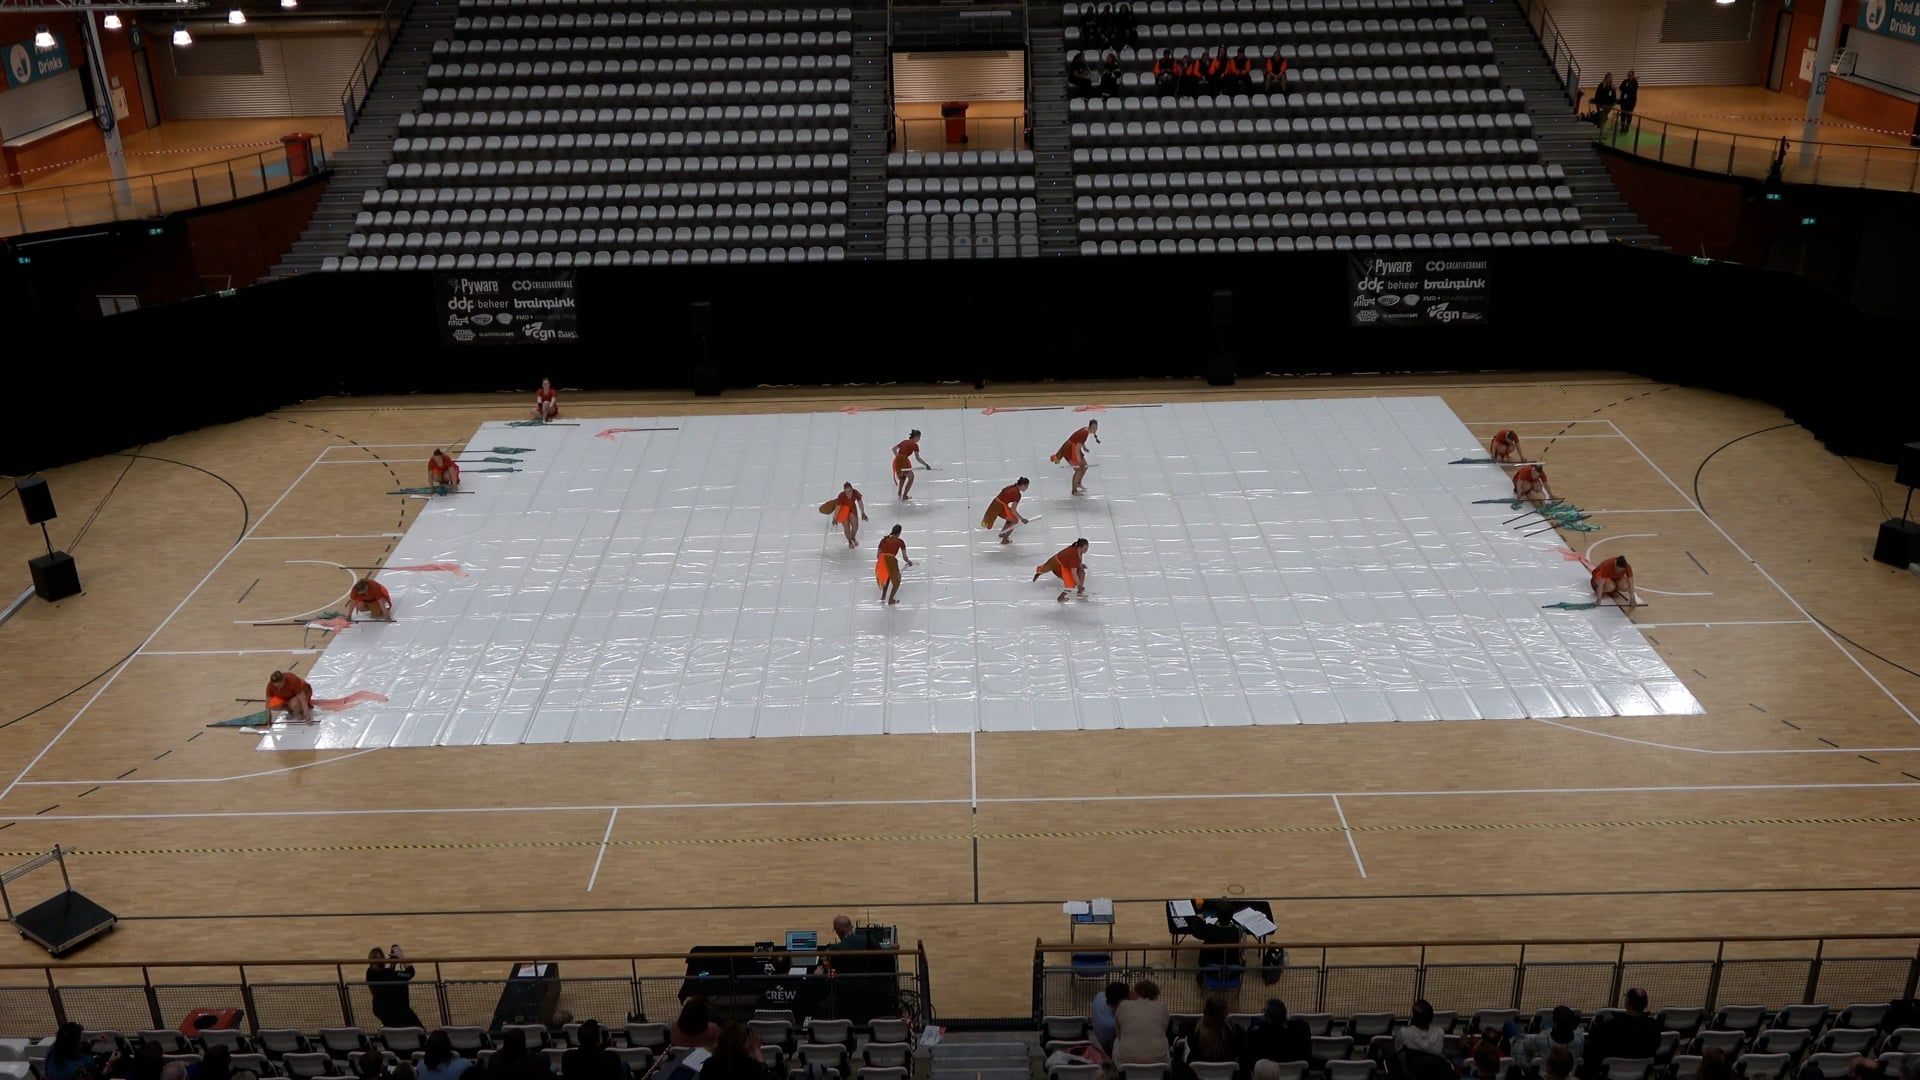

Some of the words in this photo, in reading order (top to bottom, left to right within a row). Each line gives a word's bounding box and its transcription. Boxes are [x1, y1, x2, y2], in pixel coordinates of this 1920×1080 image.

[1893, 0, 1913, 15] Food
[1889, 18, 1917, 36] Drinks
[38, 57, 63, 75] Drinks
[1375, 259, 1412, 275] Pyware
[461, 278, 499, 295] Pyware
[1358, 277, 1385, 293] ddf
[1387, 280, 1419, 290] beheer
[1424, 278, 1486, 290] brainpink
[448, 296, 475, 312] ddf
[477, 299, 509, 309] beheer
[514, 297, 575, 310] brainpink
[1436, 310, 1460, 323] cgn
[533, 329, 556, 341] cgn
[765, 990, 797, 1001] CREW
